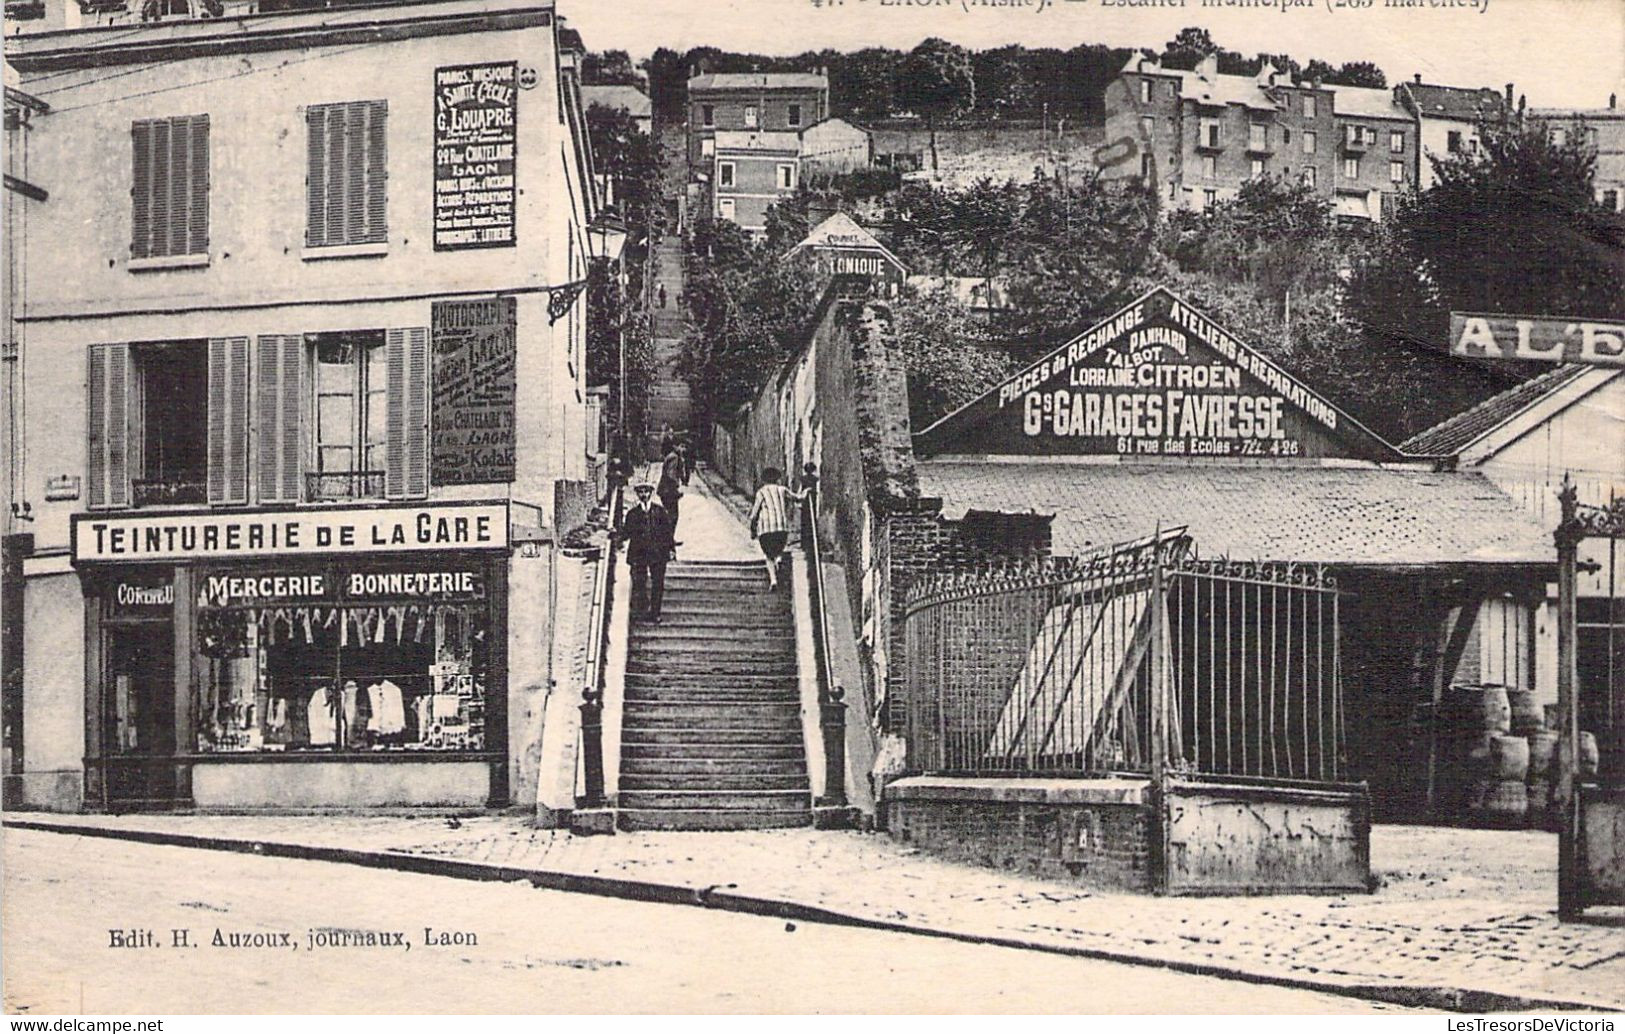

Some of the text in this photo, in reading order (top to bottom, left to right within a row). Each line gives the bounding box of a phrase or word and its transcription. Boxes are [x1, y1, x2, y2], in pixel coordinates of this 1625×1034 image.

[437, 107, 513, 131] G. LOUAPRE
[452, 163, 498, 176] LAON
[1068, 304, 1144, 366] RECHANGE
[1170, 300, 1236, 361] ATELIERS
[1137, 361, 1240, 388] CITROËN
[1053, 390, 1163, 437] GARAGES
[1166, 391, 1285, 439] FAVRESSE
[1117, 437, 1132, 453] 61
[1137, 440, 1159, 453] rue
[1164, 438, 1185, 453] des
[1191, 437, 1230, 454] Ecoles
[92, 512, 491, 554] TEINTURERIE DE LA GARE
[208, 571, 474, 601] MERCERIE BONNETERIE
